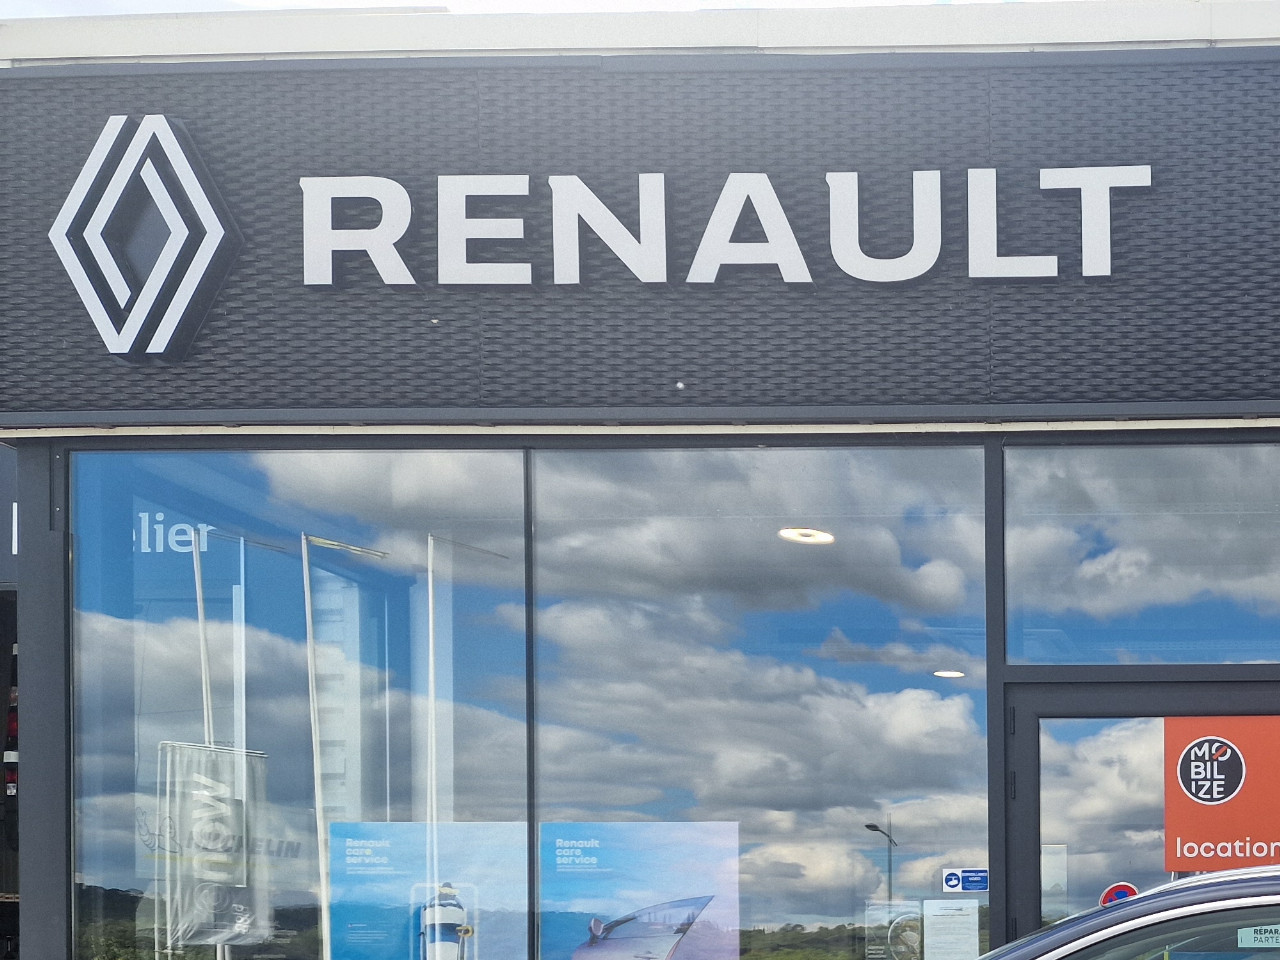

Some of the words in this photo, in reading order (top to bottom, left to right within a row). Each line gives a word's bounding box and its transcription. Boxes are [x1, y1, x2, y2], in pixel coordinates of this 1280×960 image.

[299, 164, 1152, 285] RENAULT
[133, 512, 217, 553] lier
[345, 838, 390, 848] Renault
[555, 838, 600, 848] Renault
[345, 848, 372, 856] care
[555, 848, 582, 856] care
[345, 856, 388, 864] service
[555, 856, 598, 864] service
